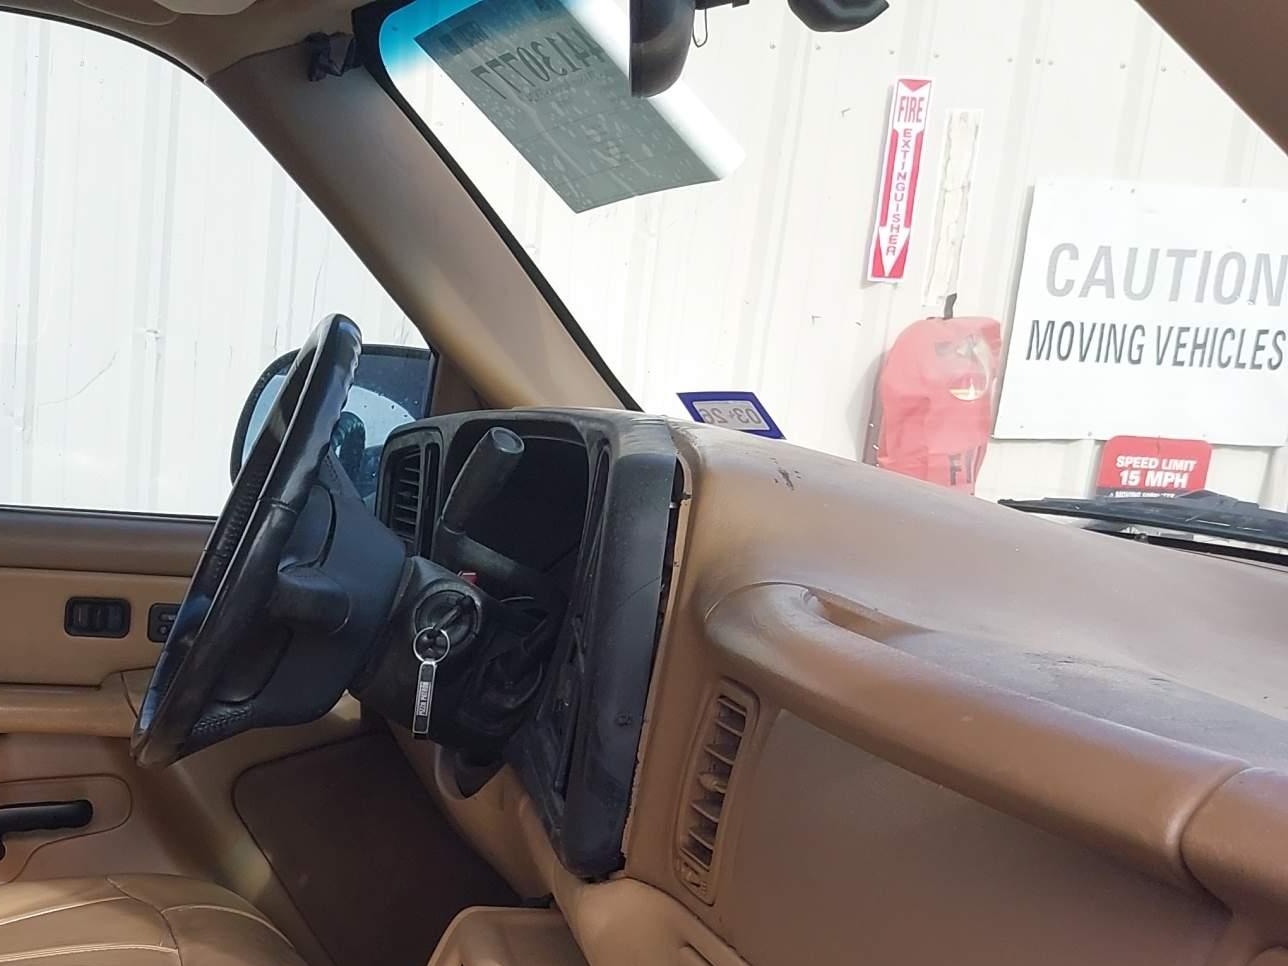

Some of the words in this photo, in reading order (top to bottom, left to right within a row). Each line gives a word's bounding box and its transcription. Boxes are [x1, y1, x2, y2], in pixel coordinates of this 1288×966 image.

[897, 96, 925, 124] FIRE
[1046, 242, 1288, 307] CAUTION
[1025, 319, 1146, 365] MOVING
[1155, 325, 1287, 371] VEHICLES
[1115, 455, 1159, 470] SPEED
[1161, 458, 1197, 472] LIMIT
[1120, 469, 1141, 487] 15
[1145, 471, 1189, 489] MPH
